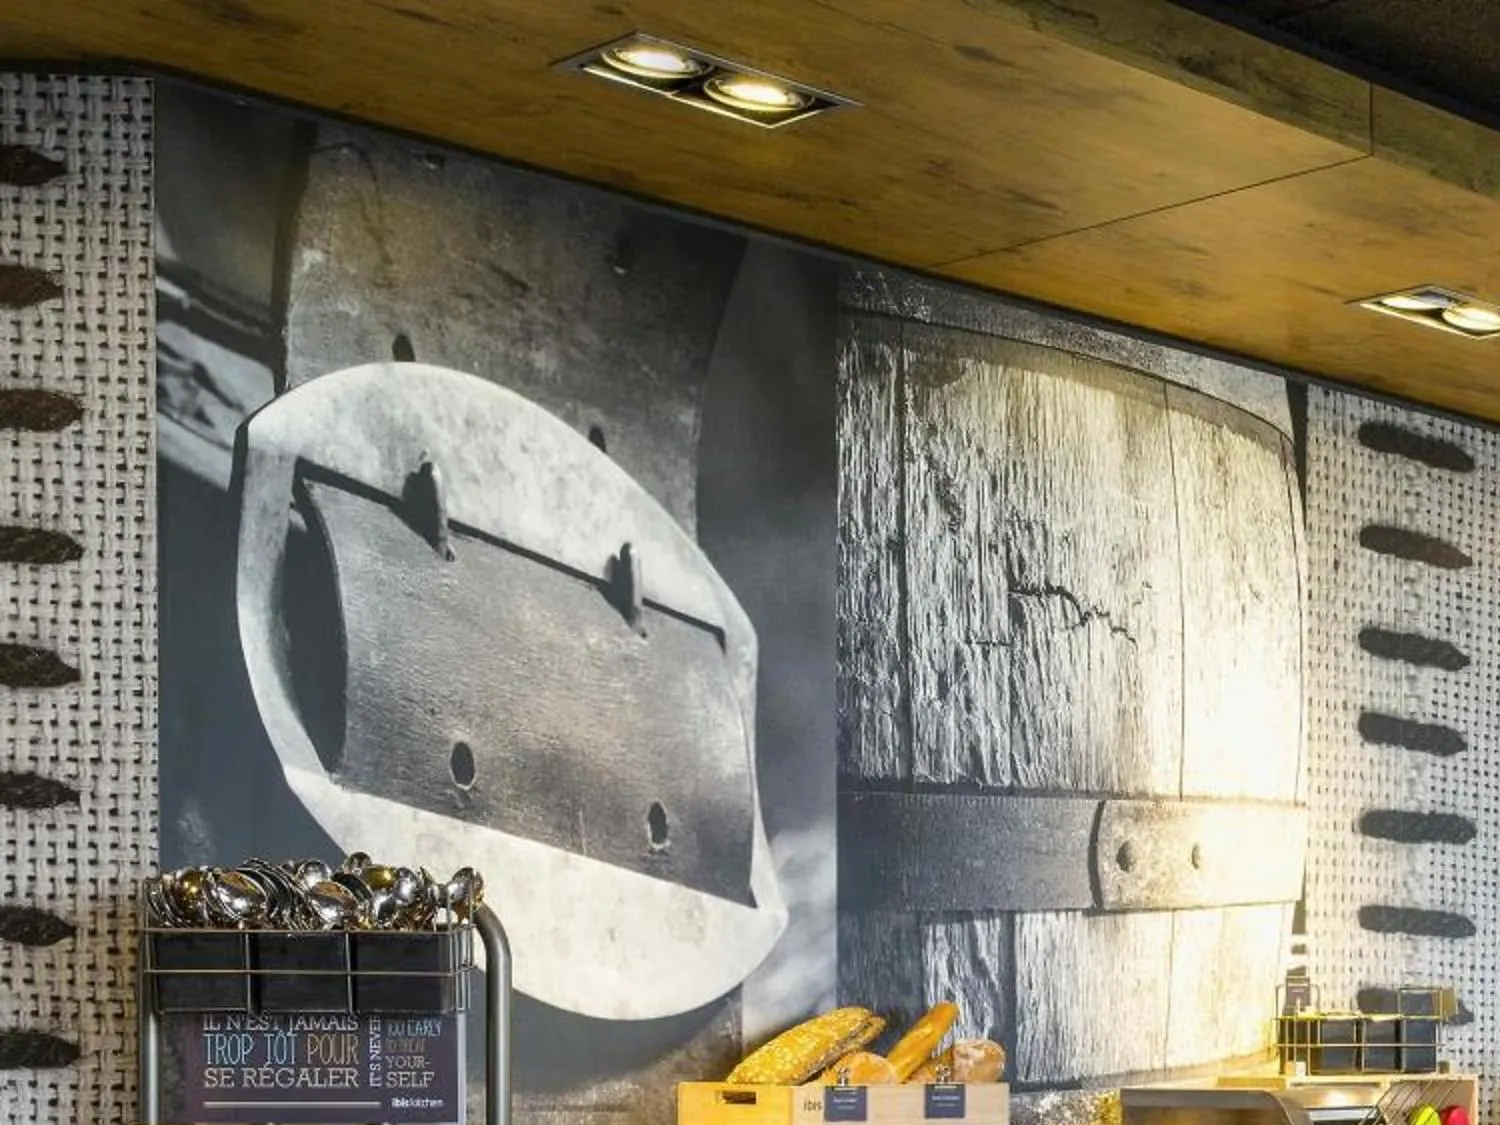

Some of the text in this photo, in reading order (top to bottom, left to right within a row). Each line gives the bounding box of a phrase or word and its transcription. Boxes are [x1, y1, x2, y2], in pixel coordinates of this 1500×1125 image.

[203, 1014, 221, 1031] IL
[287, 1014, 359, 1036] JAMAIS
[203, 1033, 254, 1065] TROP
[264, 1029, 297, 1065] TÔT
[306, 1033, 360, 1065] POUR
[203, 1062, 360, 1089] SE RÉGALER
[385, 1071, 435, 1089] SELF
